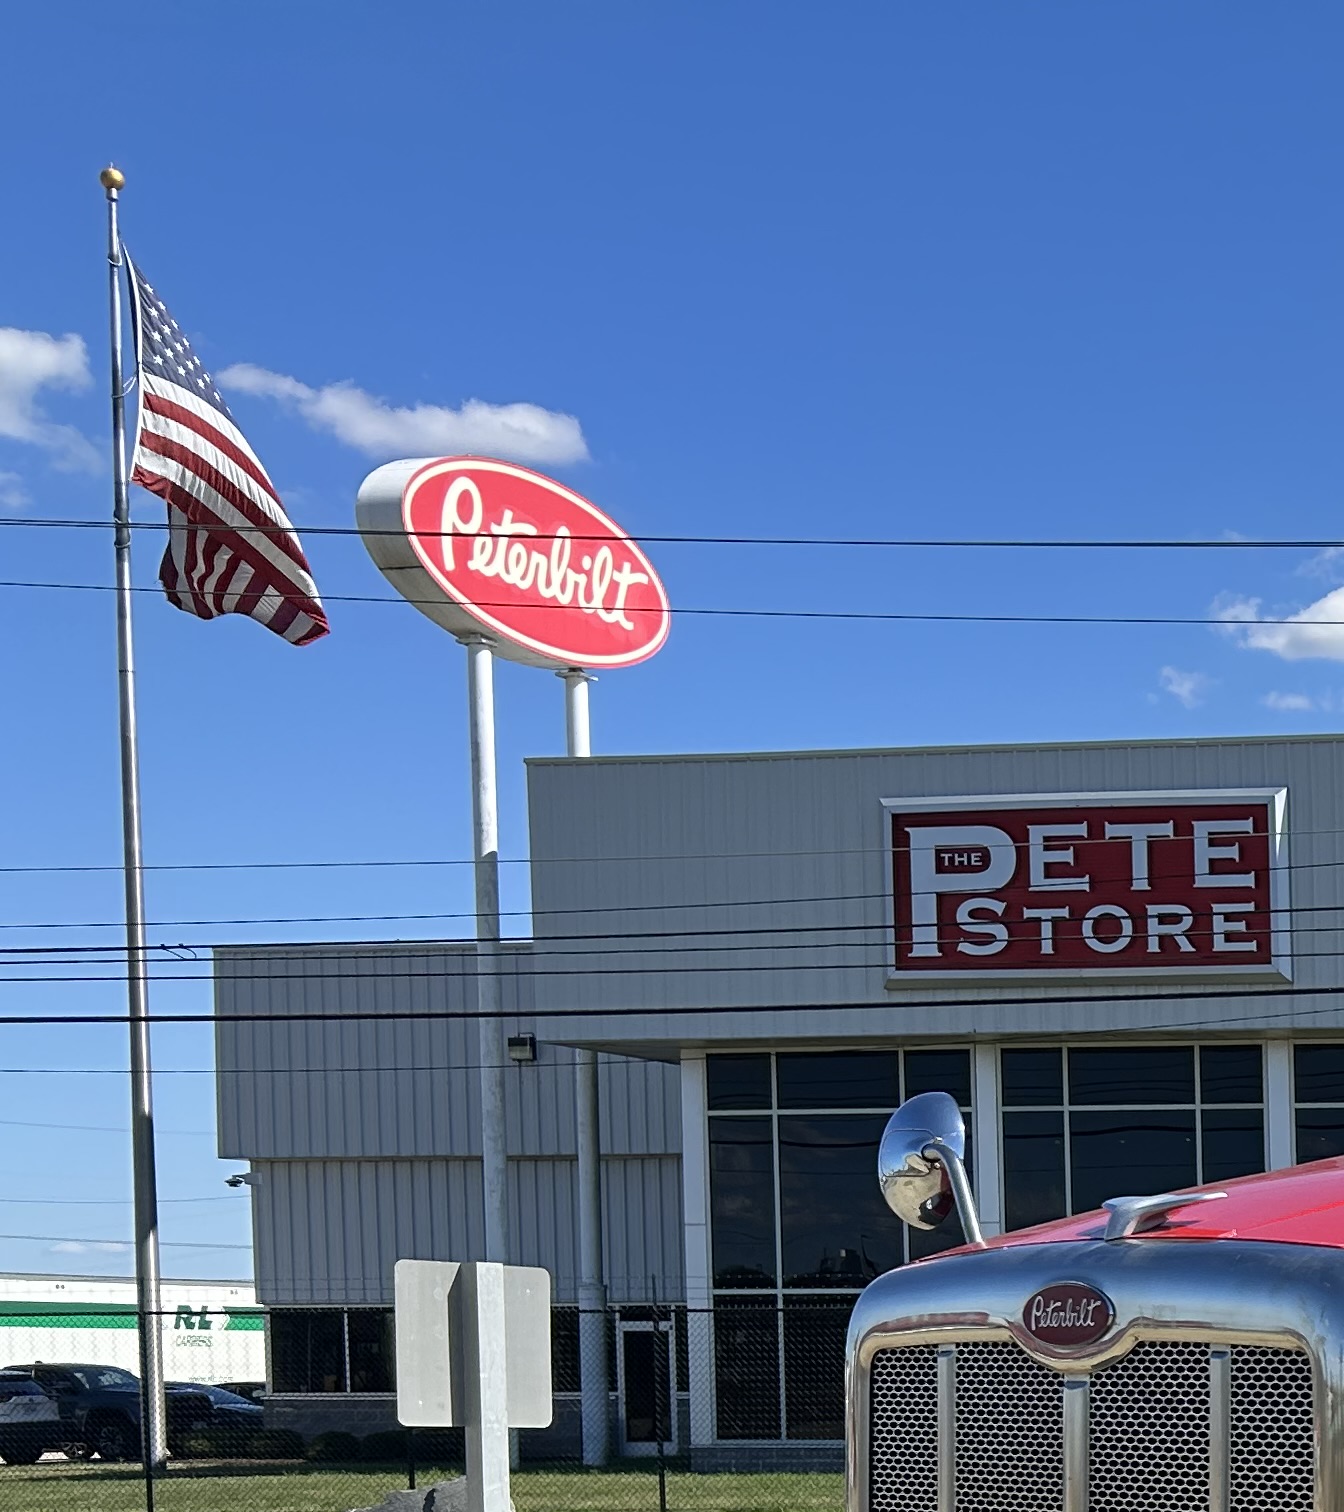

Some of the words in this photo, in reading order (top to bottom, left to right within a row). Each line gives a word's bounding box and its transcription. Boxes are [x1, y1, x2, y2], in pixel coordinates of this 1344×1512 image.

[441, 476, 649, 631] Peterbilt
[904, 816, 1256, 958] PETE
[940, 852, 984, 867] THE
[955, 897, 1258, 956] STORE
[1031, 1296, 1102, 1331] Peterbilt
